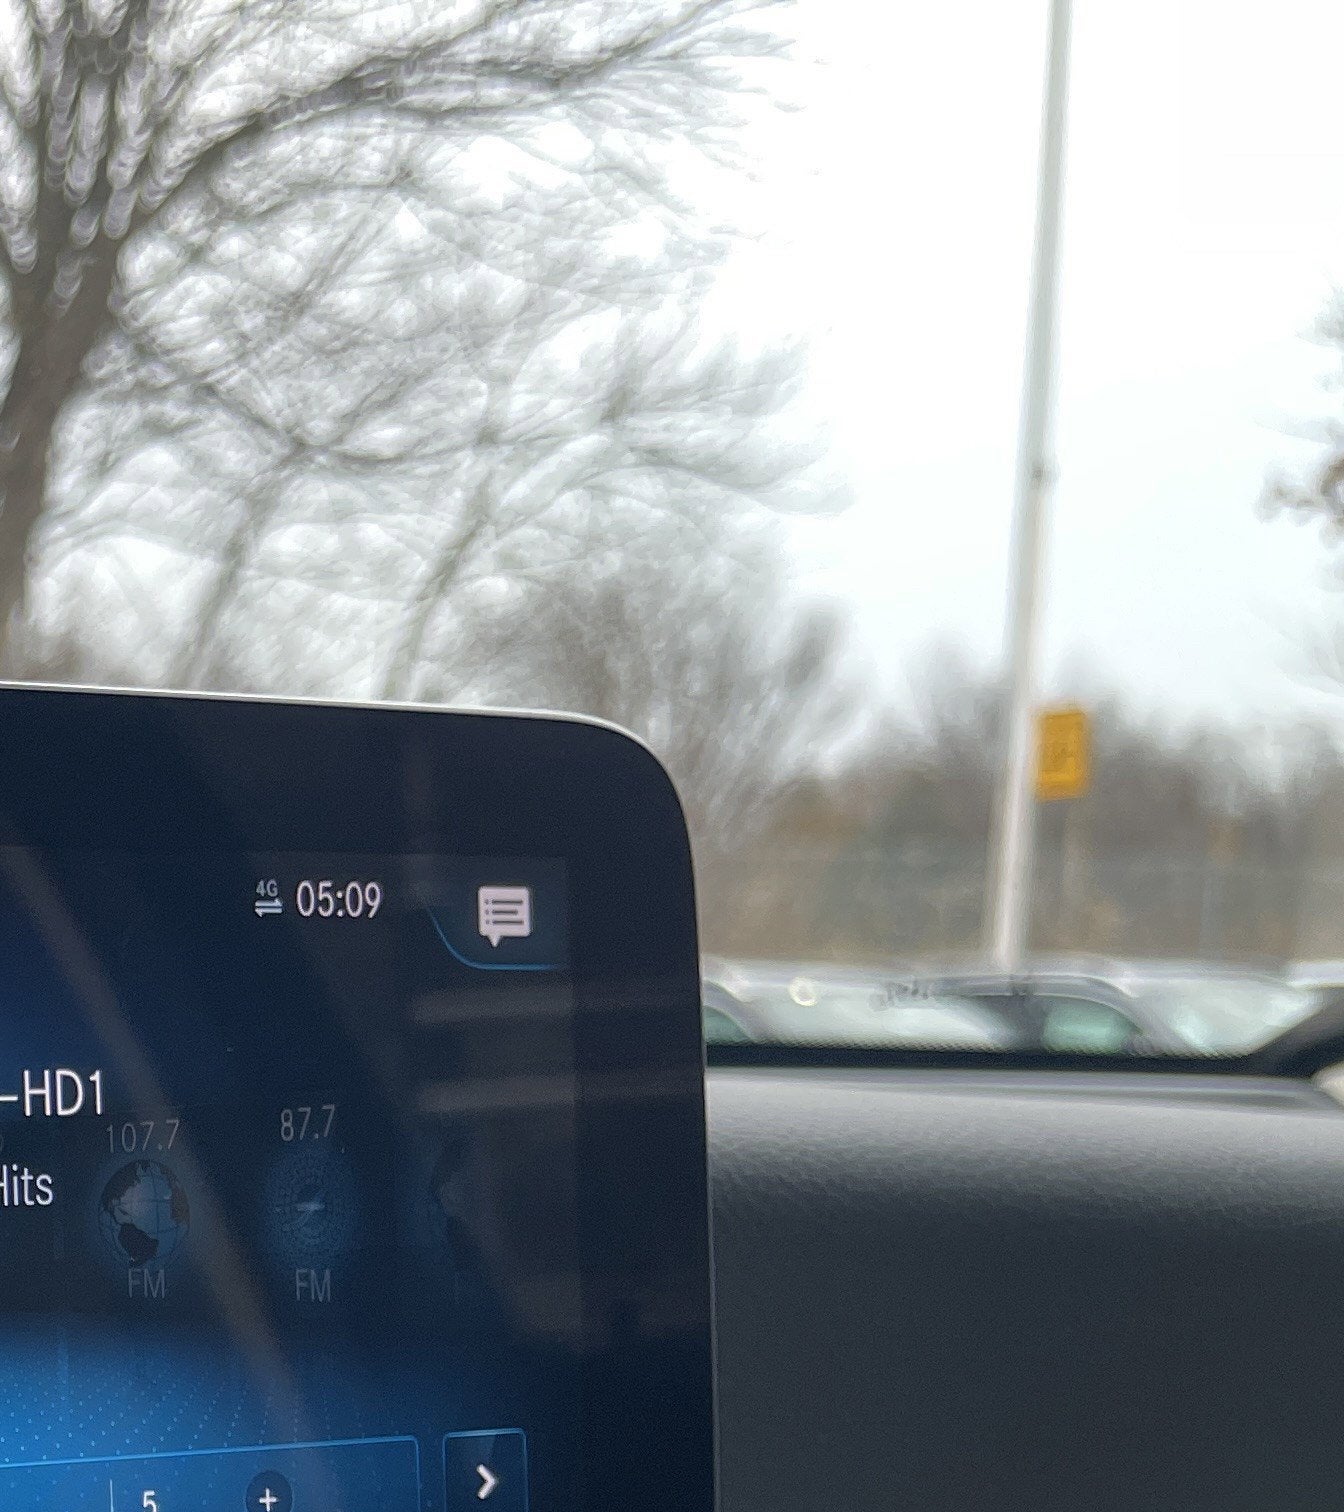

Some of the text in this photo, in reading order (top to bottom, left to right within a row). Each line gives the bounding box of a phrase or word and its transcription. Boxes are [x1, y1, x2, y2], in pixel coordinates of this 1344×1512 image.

[296, 879, 381, 918] 05:09
[106, 1118, 180, 1153] 107.7
[279, 1104, 337, 1142] 87.7
[127, 1267, 166, 1299] FM
[294, 1267, 332, 1302] FM
